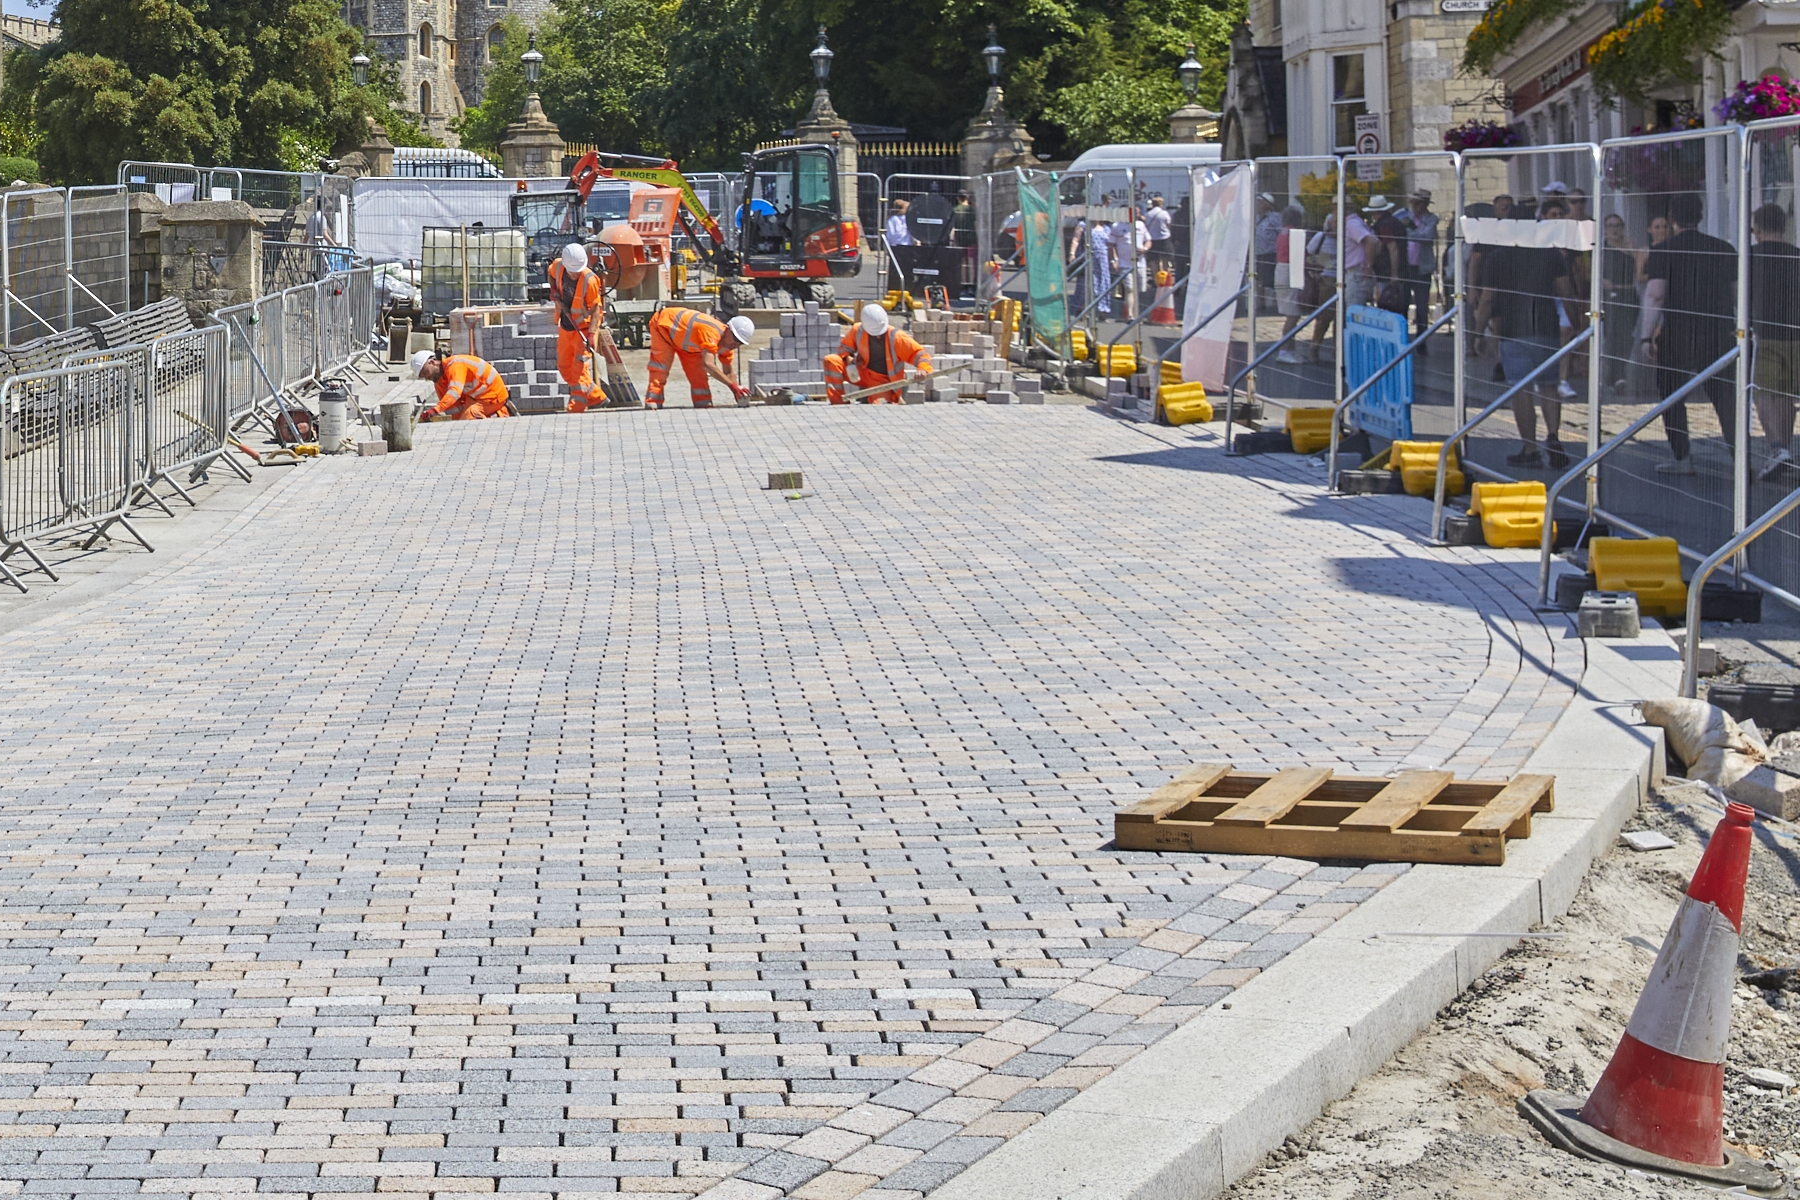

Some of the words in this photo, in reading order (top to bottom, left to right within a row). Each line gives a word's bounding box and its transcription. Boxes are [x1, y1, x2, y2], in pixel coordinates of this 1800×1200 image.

[1445, 1, 1479, 9] CHURCH
[1357, 122, 1378, 130] ZONE
[620, 170, 657, 180] RANGER
[1109, 188, 1162, 200] Allince
